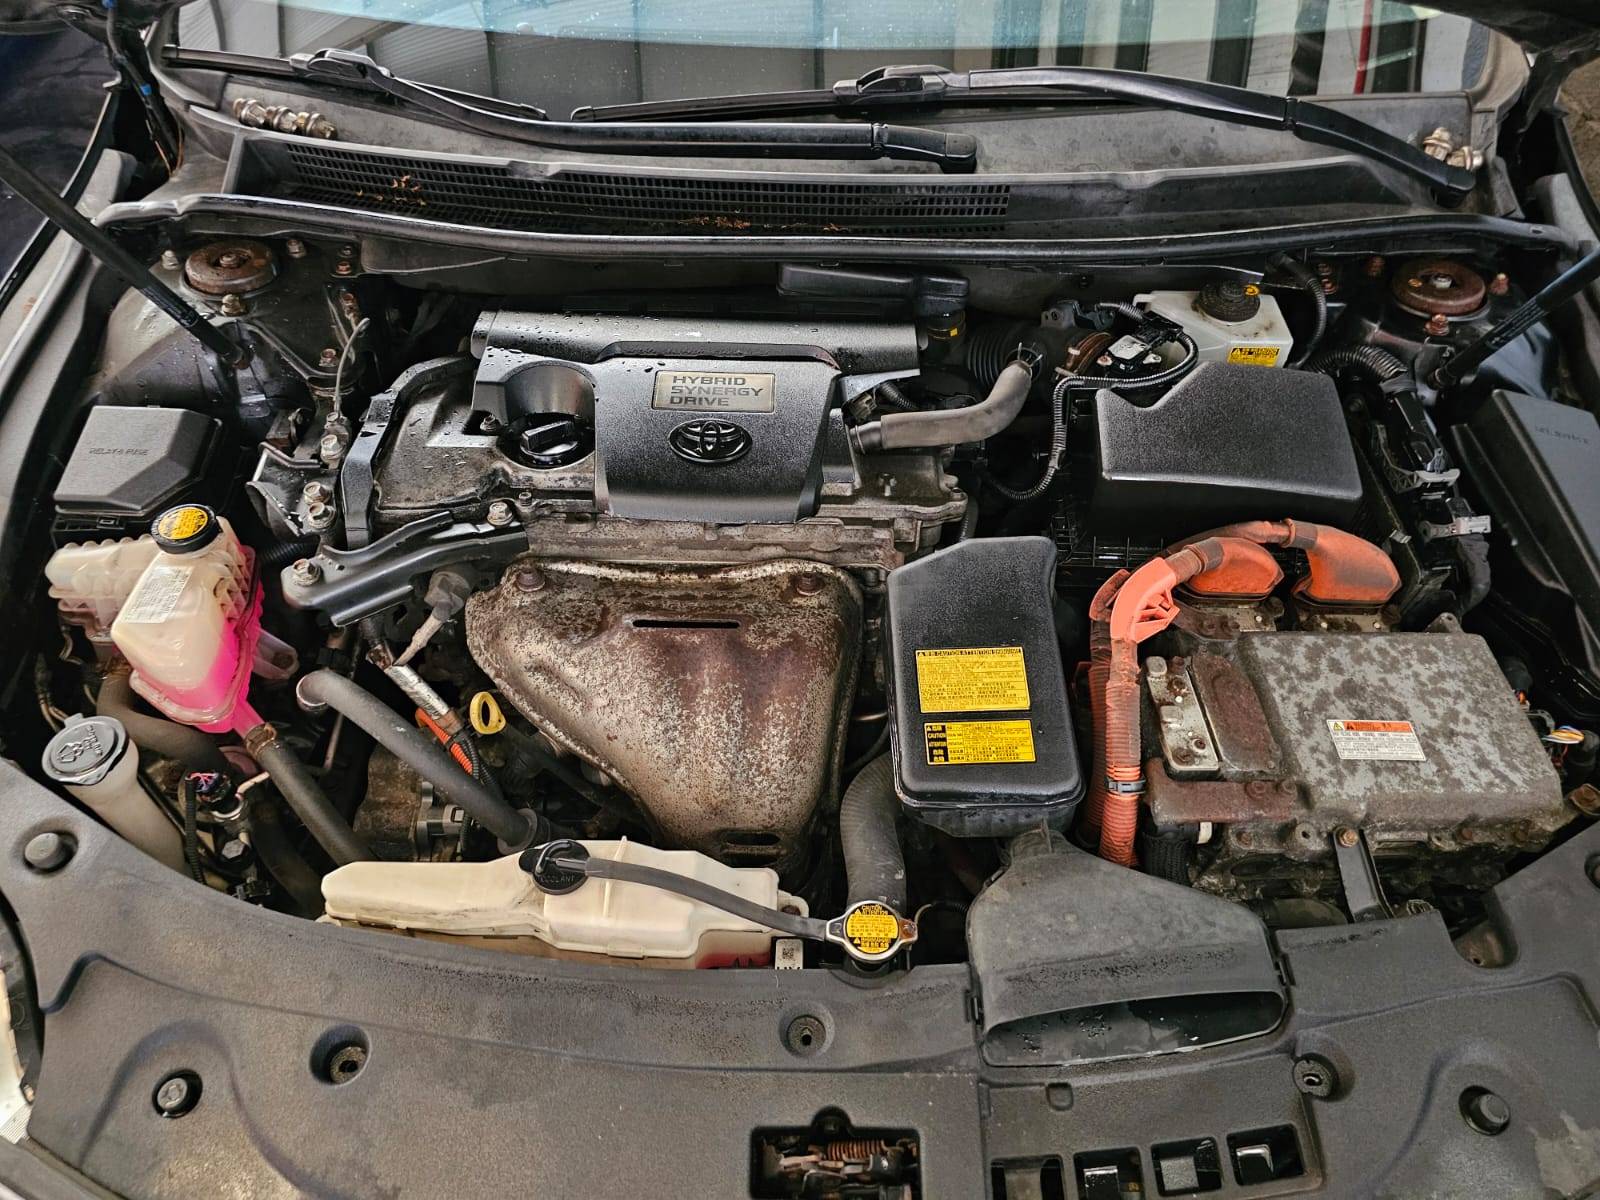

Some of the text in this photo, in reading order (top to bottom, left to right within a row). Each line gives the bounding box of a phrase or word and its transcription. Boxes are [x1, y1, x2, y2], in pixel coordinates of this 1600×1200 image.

[672, 375, 746, 386] HYBRID
[670, 385, 763, 397] SYNERGY
[669, 396, 729, 407] DRIVE
